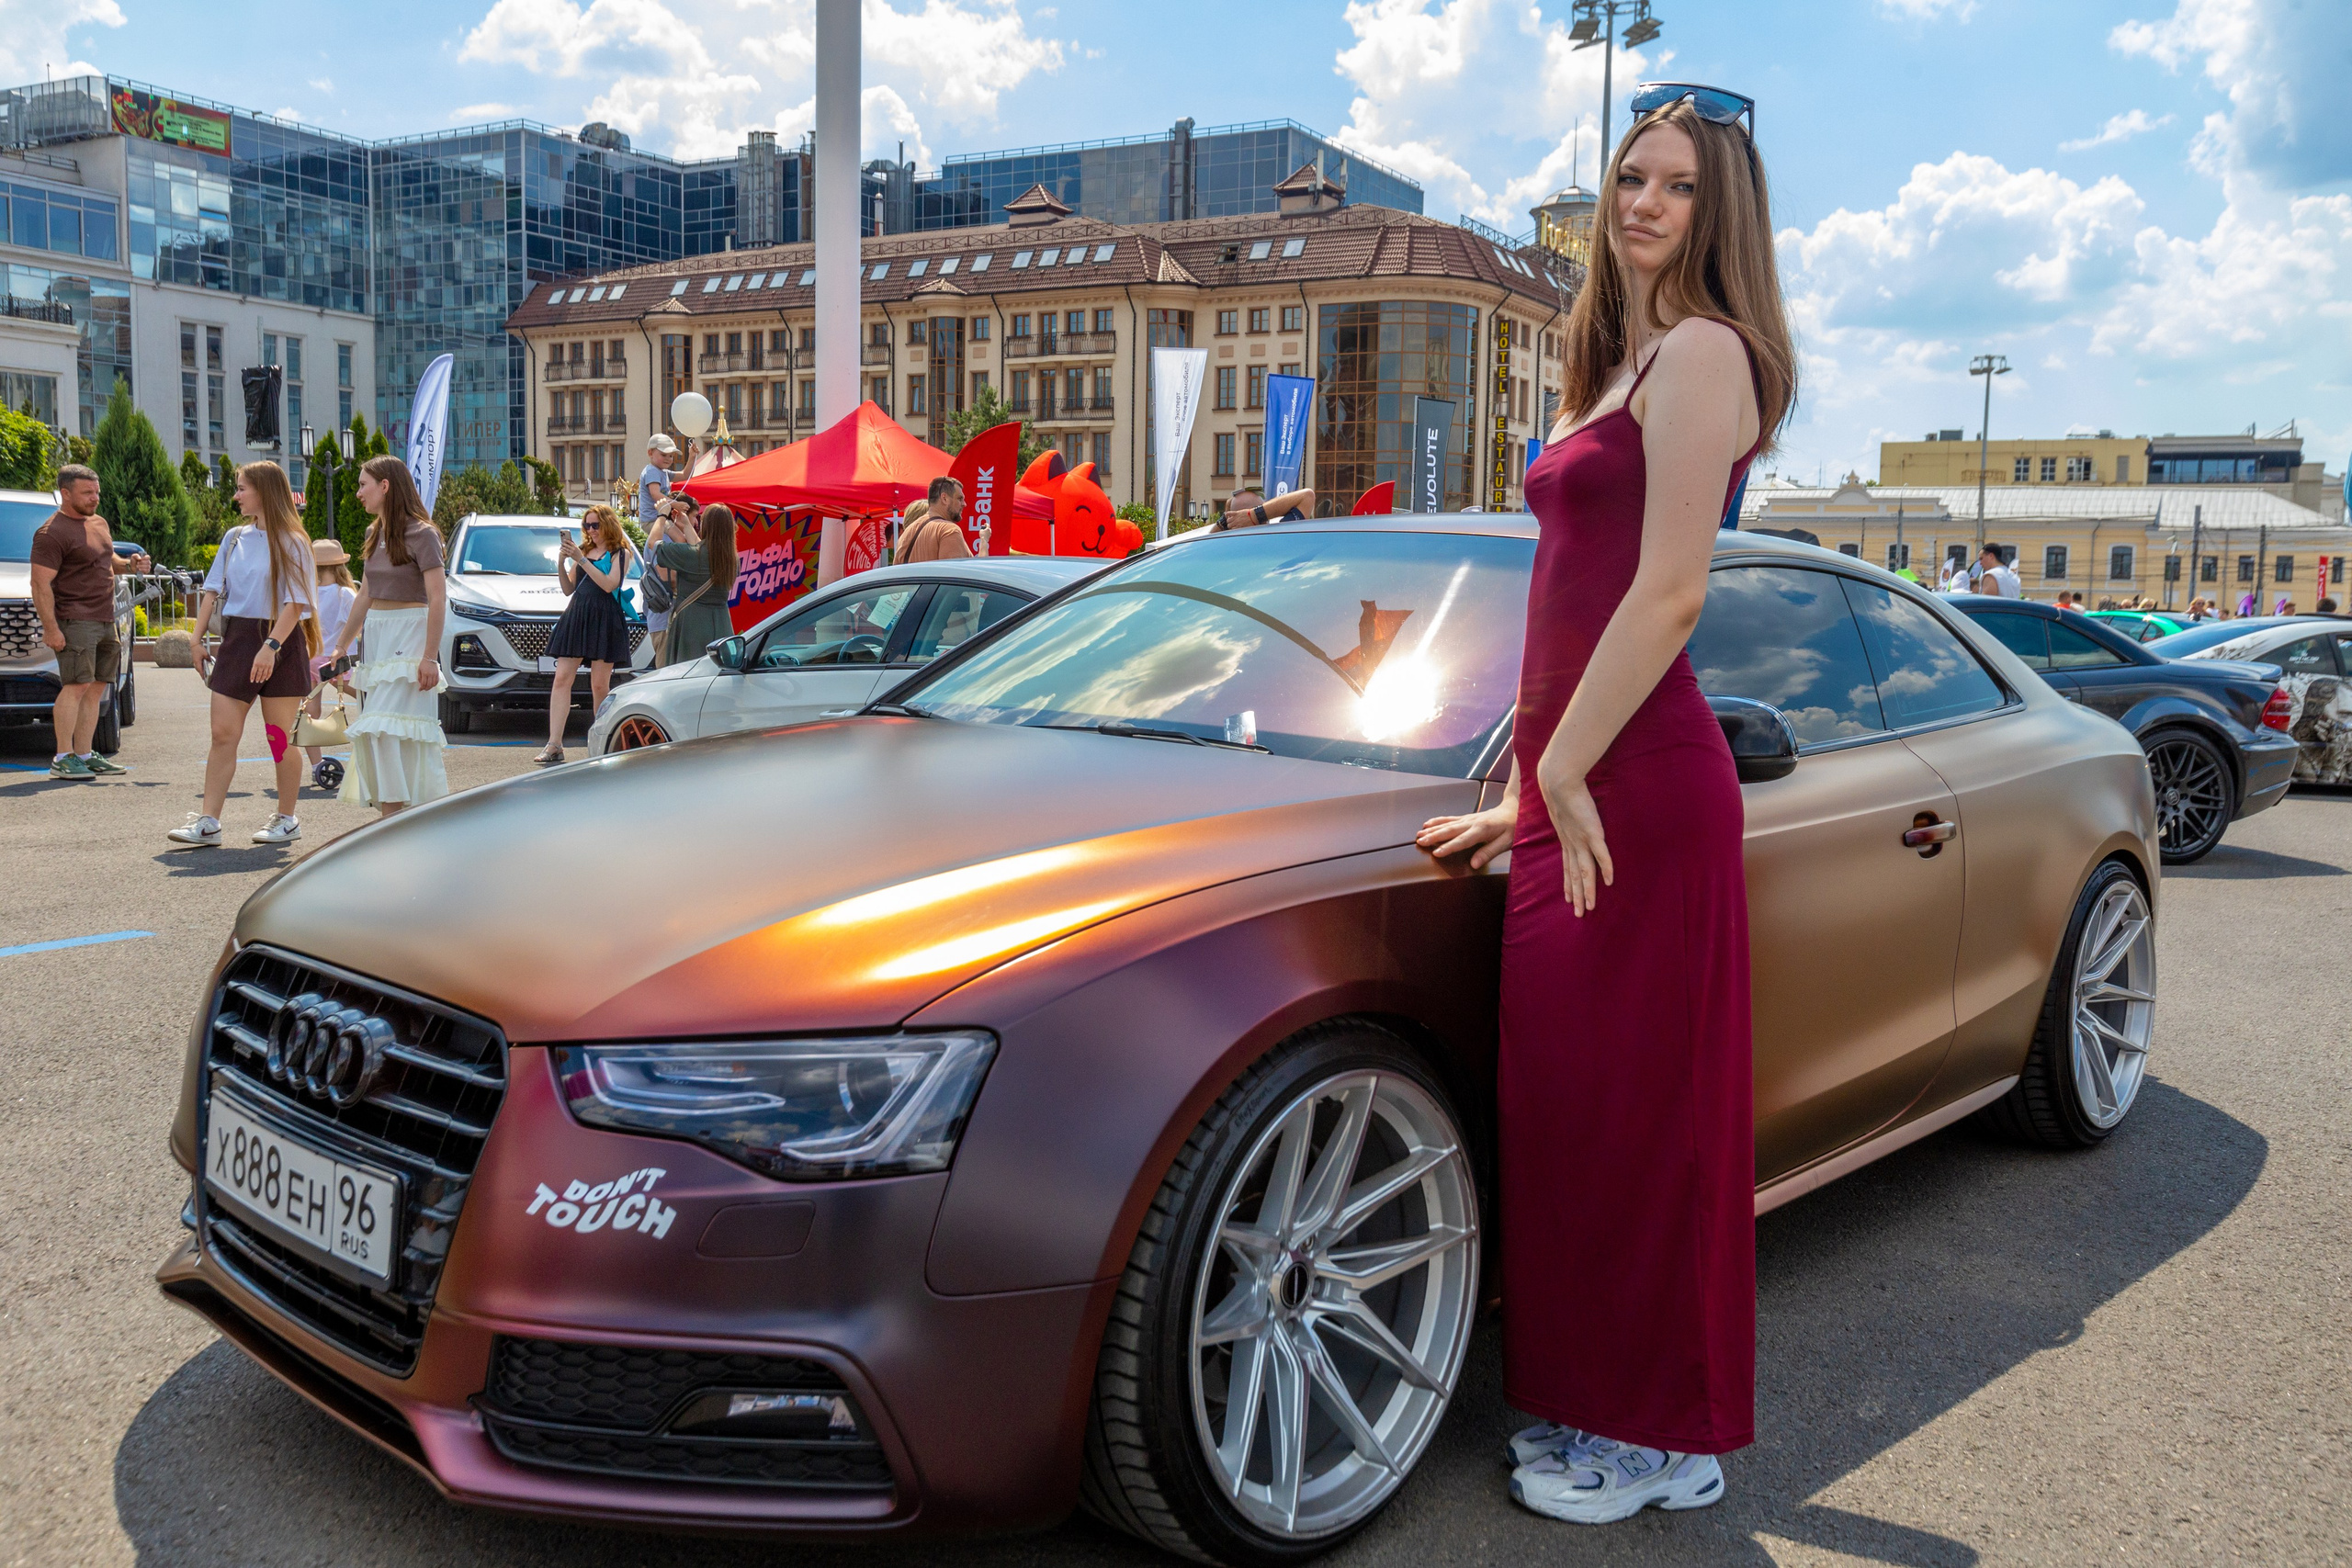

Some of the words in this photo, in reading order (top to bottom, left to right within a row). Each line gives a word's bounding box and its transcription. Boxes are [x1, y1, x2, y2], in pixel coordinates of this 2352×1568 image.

[1498, 321, 1509, 393] HOTEL
[1281, 413, 1290, 440] Эксперт
[738, 538, 794, 573] ЛЬФА
[847, 540, 872, 570] СТИЛЬ
[729, 558, 804, 601] ГОДНО
[562, 1168, 667, 1204] DON'T
[339, 1175, 376, 1235] 96
[526, 1182, 677, 1239] TOUCH
[341, 1232, 369, 1259] RUS
